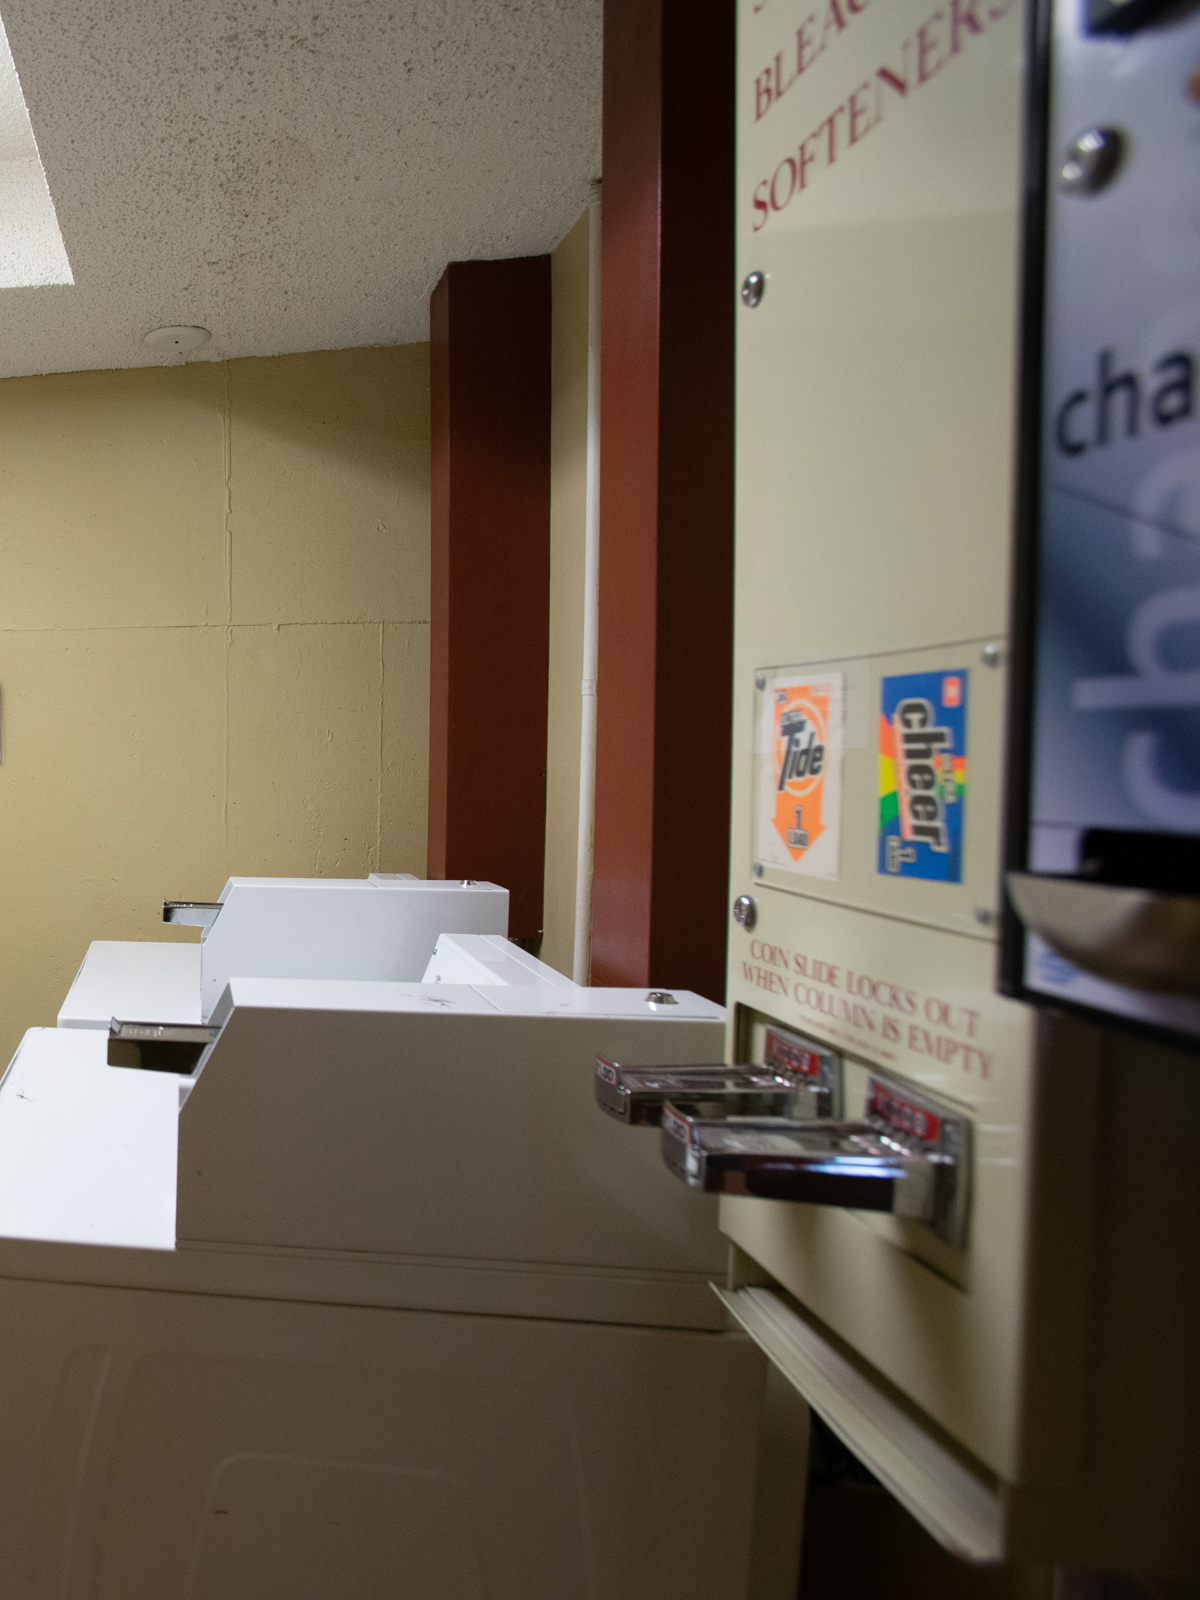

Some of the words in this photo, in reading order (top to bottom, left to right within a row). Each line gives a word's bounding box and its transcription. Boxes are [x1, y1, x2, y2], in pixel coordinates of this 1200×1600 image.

[752, 0, 870, 124] BLEA
[777, 718, 825, 792] Tide
[898, 700, 949, 851] cheer
[742, 961, 789, 998] WHEN
[794, 982, 875, 1033] COLUMN
[882, 1013, 900, 1043] IS
[908, 1024, 991, 1080] EMPTY
[750, 939, 789, 970] COIN
[794, 953, 840, 989] SLIDE
[846, 970, 918, 1016] LOCKS
[924, 995, 980, 1038] OUT
